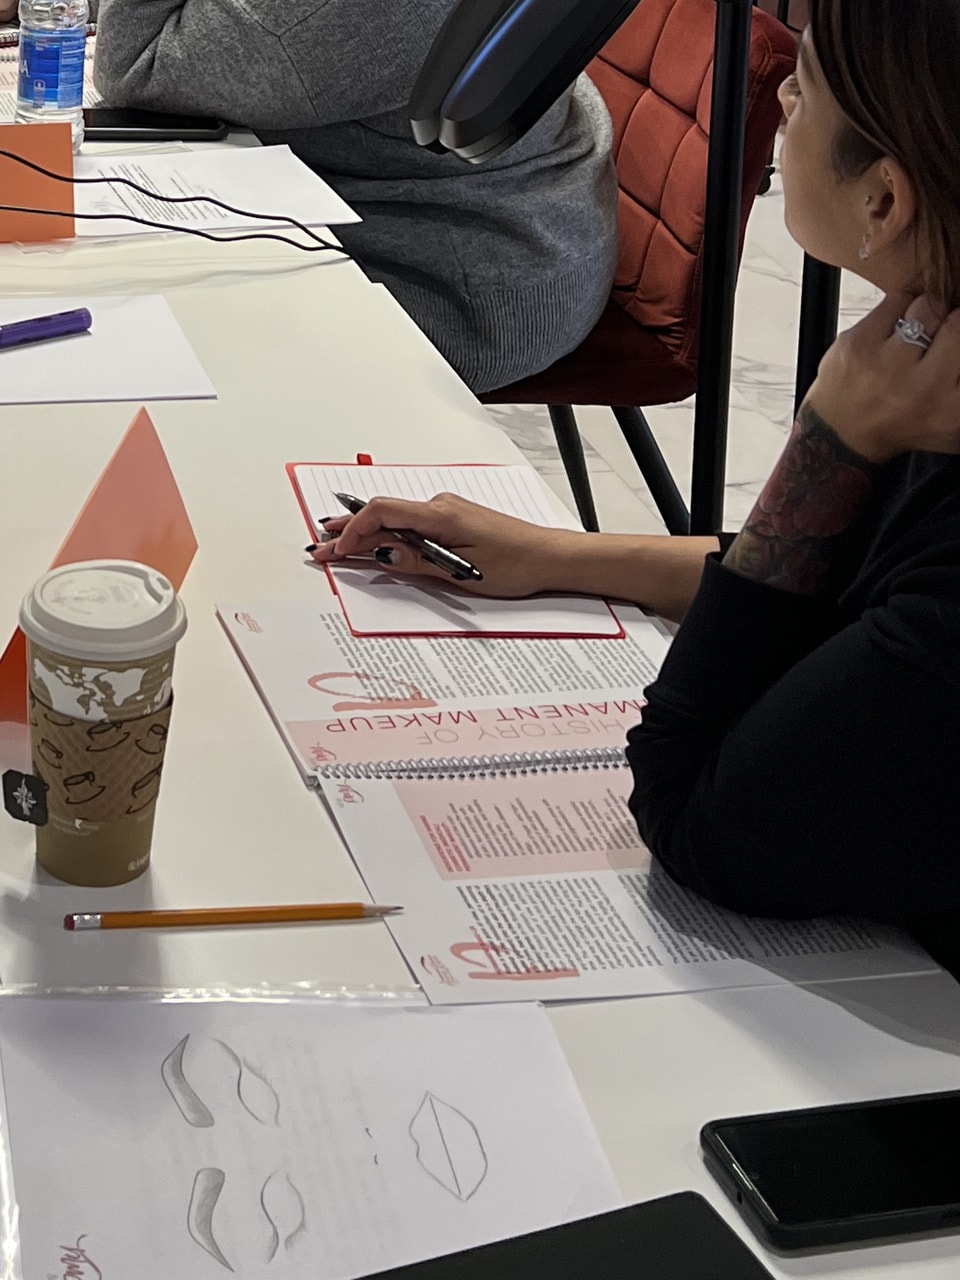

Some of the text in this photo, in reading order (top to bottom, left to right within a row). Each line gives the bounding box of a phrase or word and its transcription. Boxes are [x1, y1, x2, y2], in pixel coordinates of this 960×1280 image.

[326, 698, 645, 732] MANENT MAKEUP
[415, 718, 626, 745] HISTORY OF
